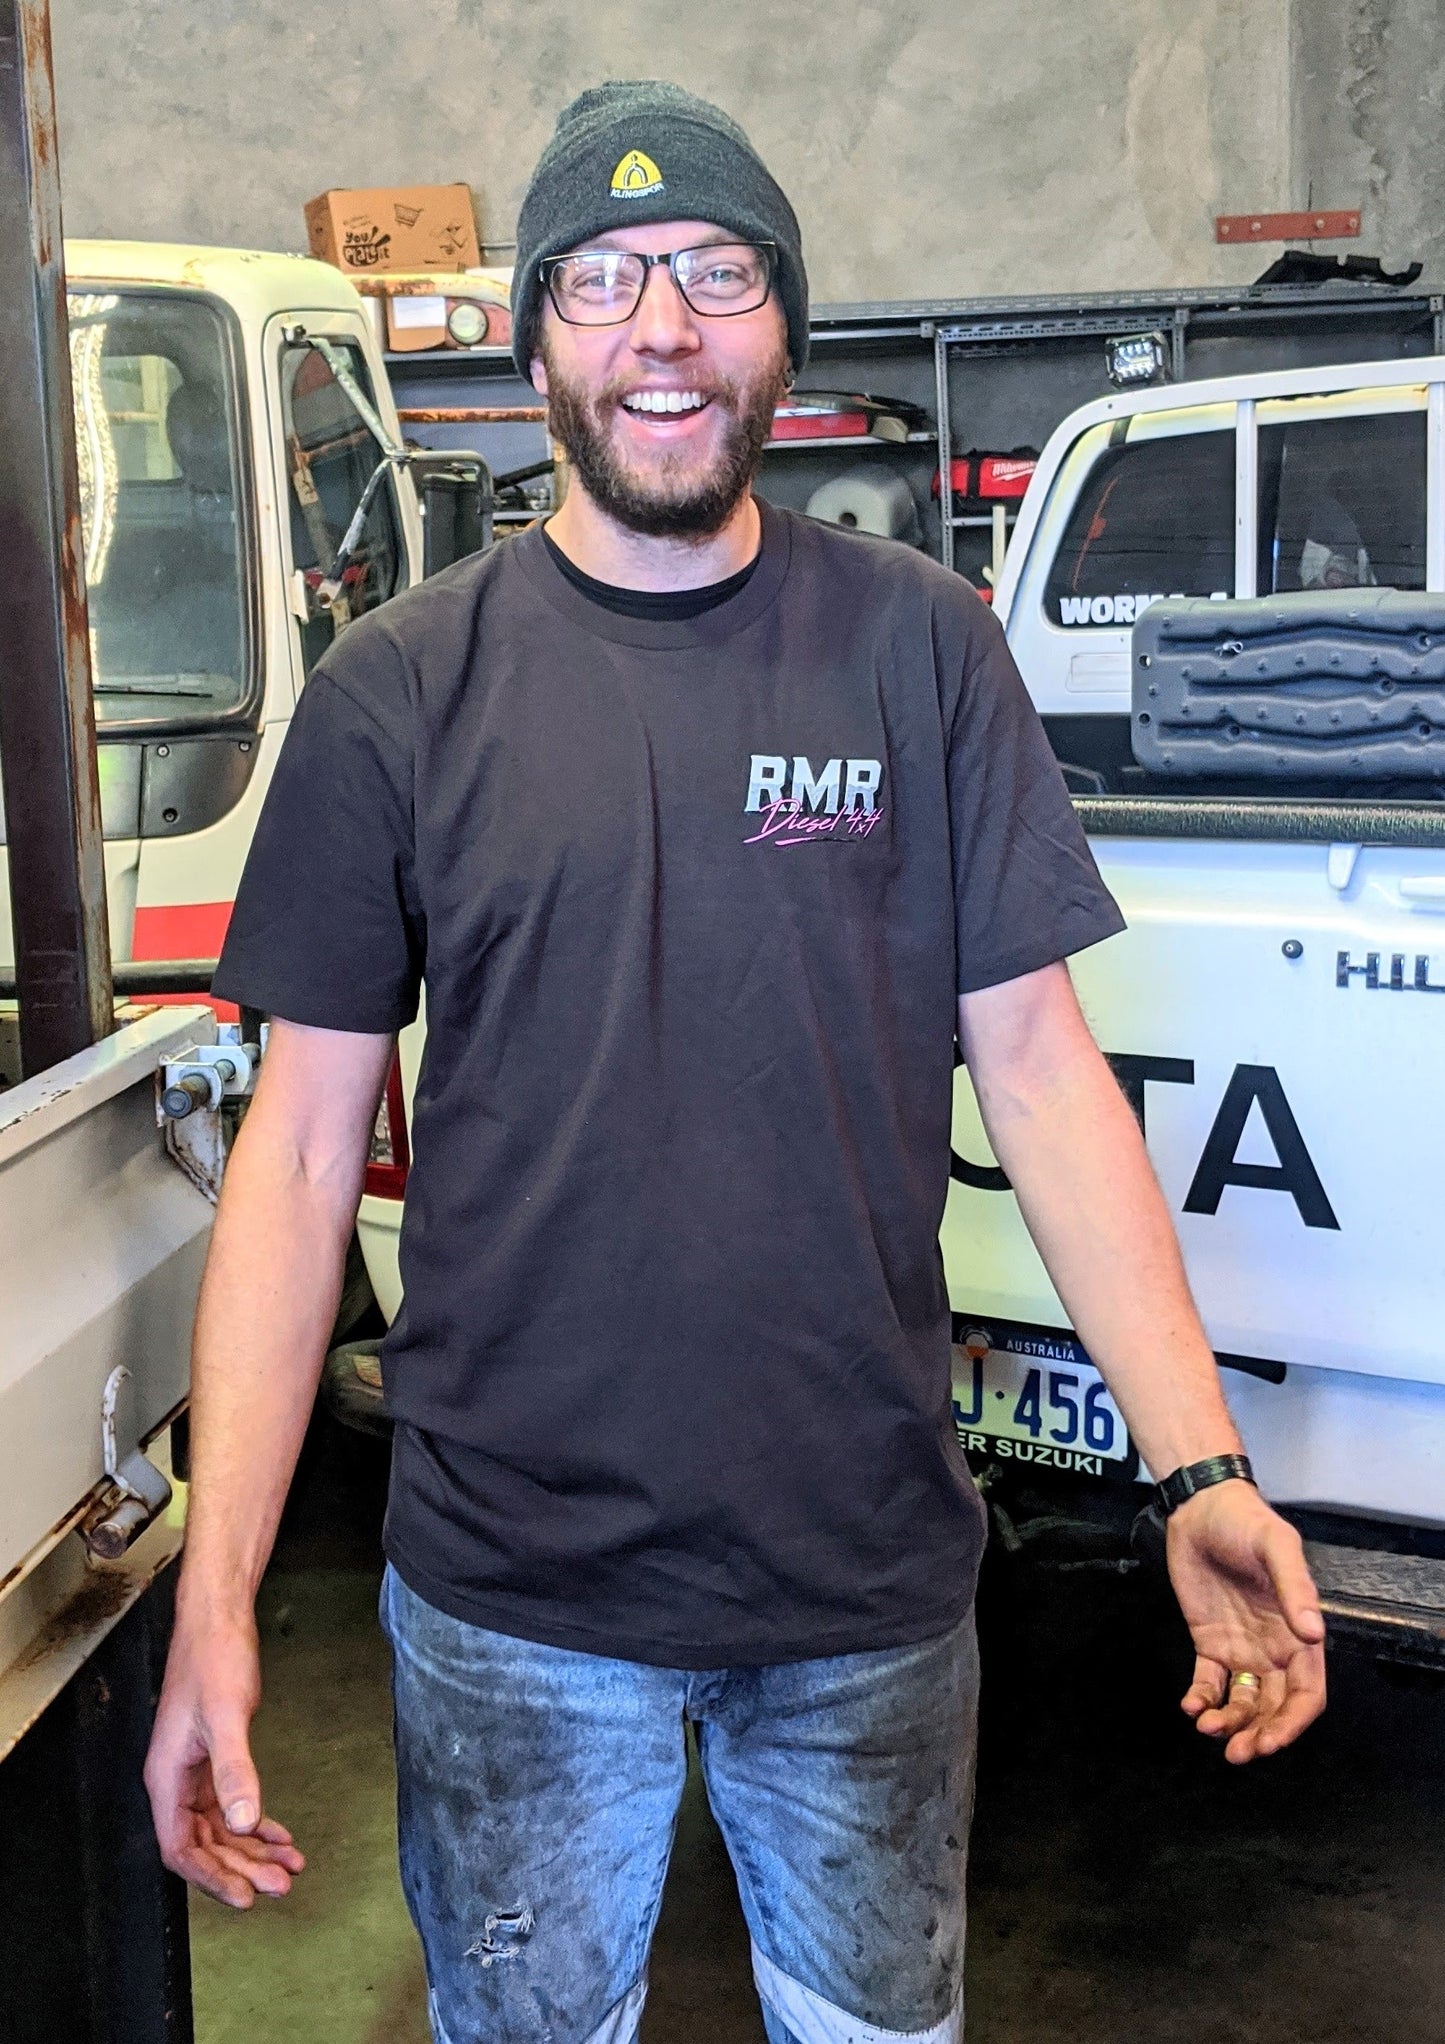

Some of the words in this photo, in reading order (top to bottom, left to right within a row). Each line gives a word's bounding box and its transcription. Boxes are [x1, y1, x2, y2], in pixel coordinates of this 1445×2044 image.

[744, 754, 882, 816] RMR
[743, 797, 848, 844] Diesel
[846, 807, 884, 838] 4x4
[1007, 1339, 1075, 1361] AUSTRALIA
[995, 1439, 1103, 1476] SUZUKI
